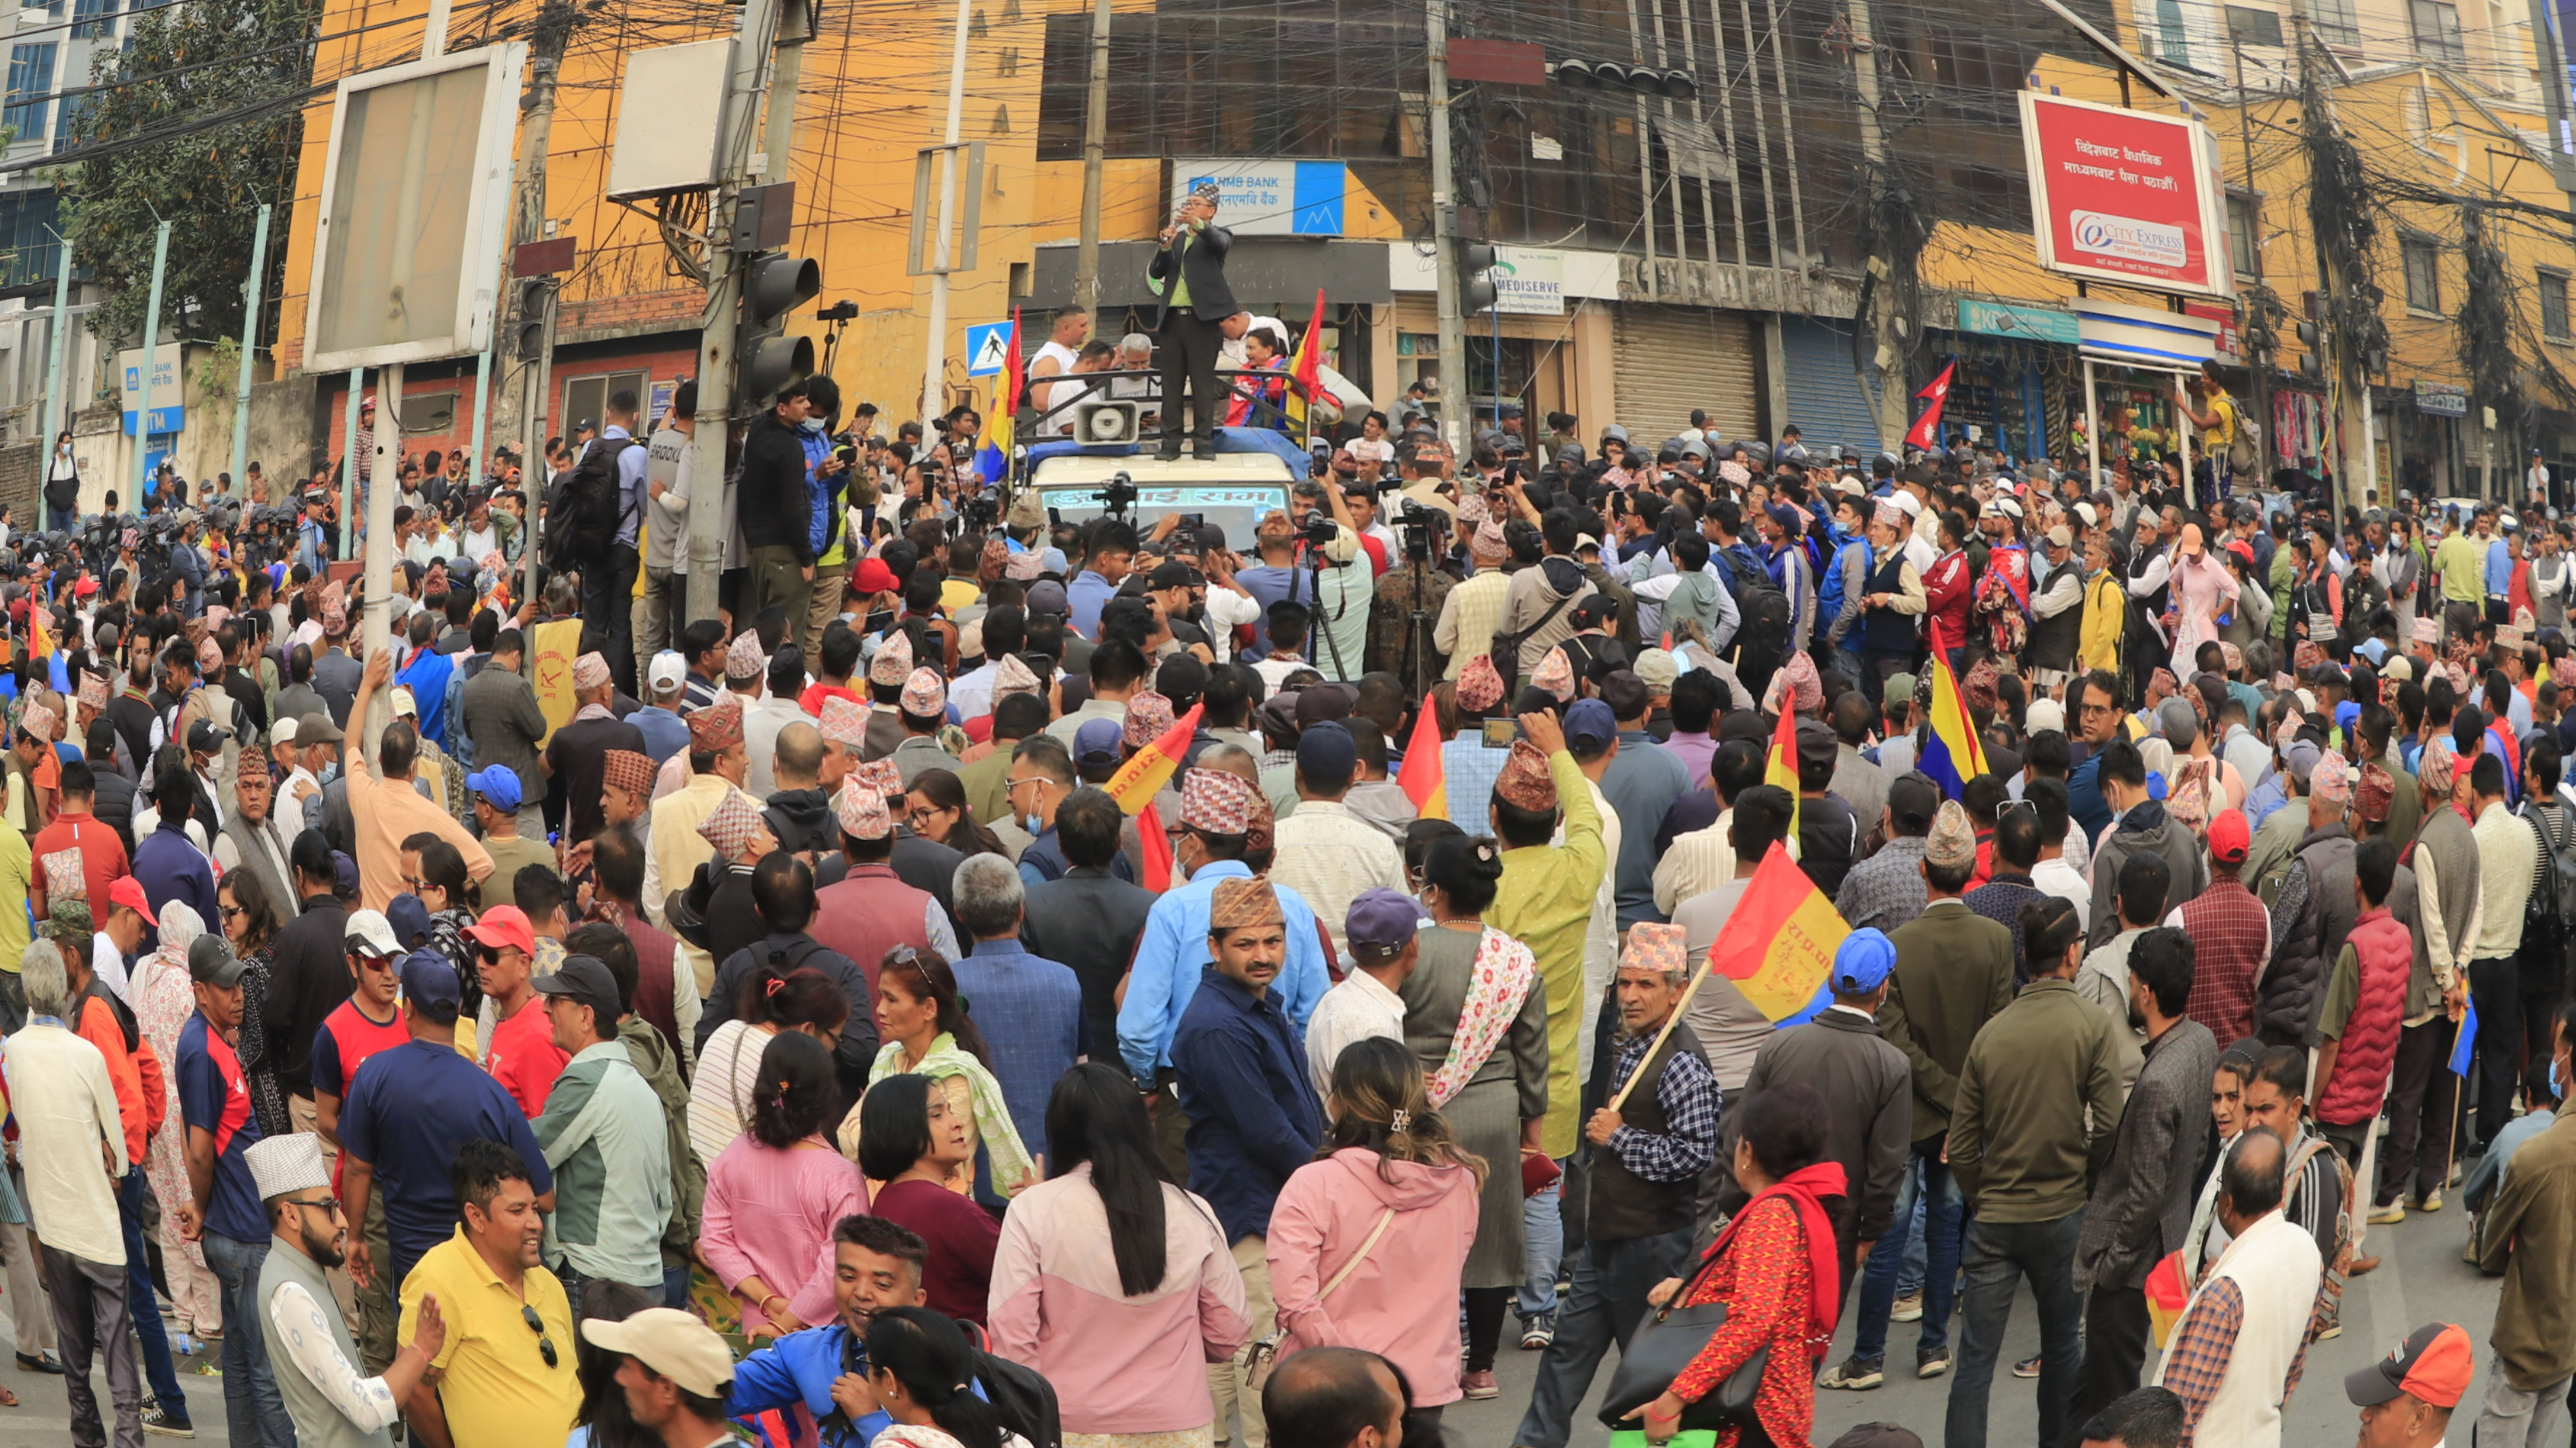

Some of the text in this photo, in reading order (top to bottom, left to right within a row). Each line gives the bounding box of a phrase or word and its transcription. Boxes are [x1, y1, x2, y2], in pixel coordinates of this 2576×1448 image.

[2075, 138, 2162, 166] विदेशबाट वैधानिक
[1218, 177, 1279, 188] NMB BANK
[2063, 161, 2115, 181] माध्यमबाट
[2118, 167, 2139, 185] पैसा
[2104, 223, 2182, 249] CITY EXPRESS
[1497, 279, 1560, 293] MEDISERVE
[154, 362, 172, 373] BANK
[147, 411, 165, 431] TM
[650, 444, 681, 463] BROOKL
[1194, 491, 1272, 503] राम
